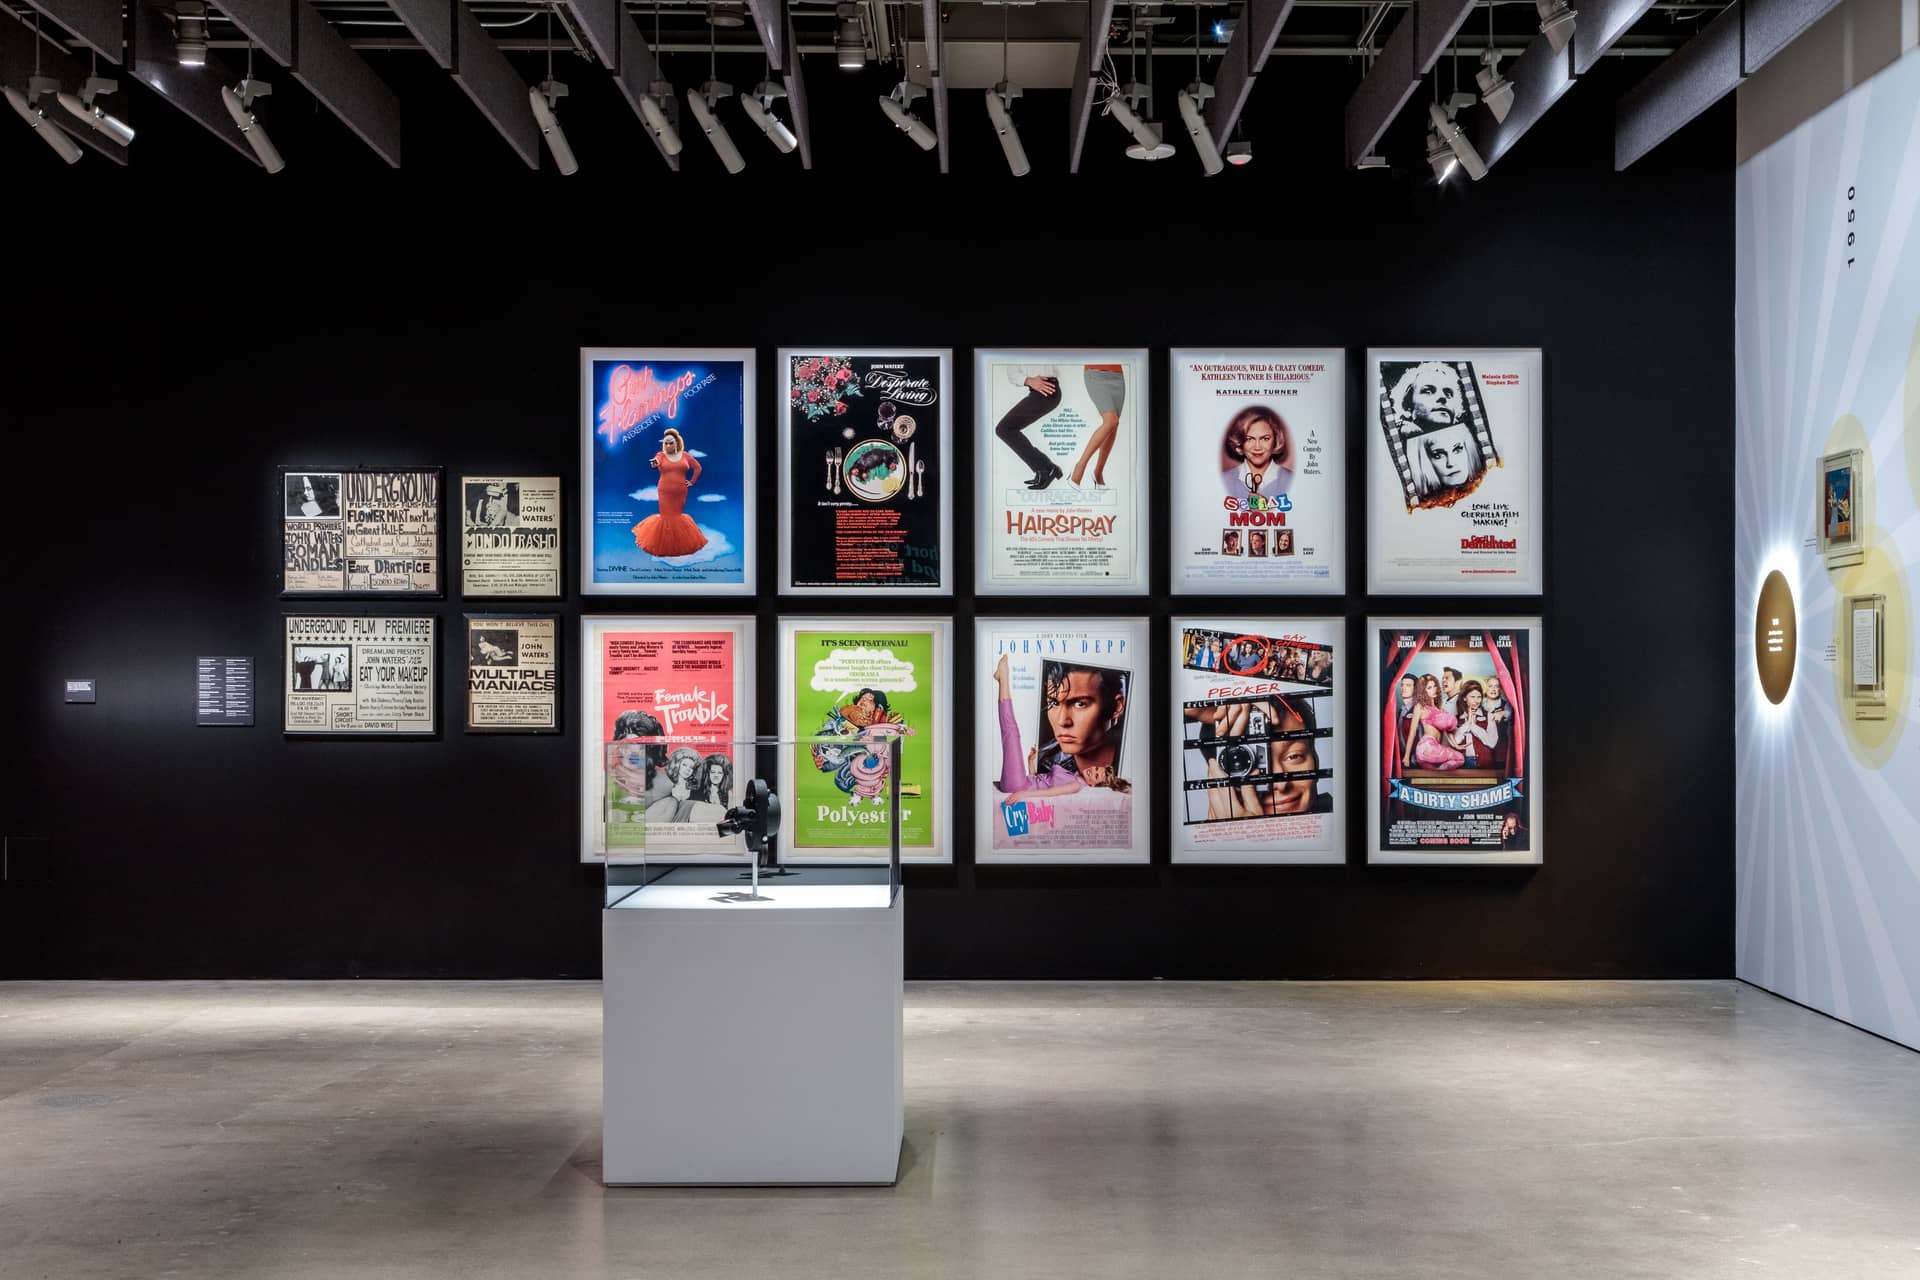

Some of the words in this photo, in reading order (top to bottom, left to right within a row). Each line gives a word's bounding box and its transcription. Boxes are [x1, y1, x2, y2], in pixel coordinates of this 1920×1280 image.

[1848, 186, 1856, 269] 1950
[1204, 364, 1248, 372] OUTRAGEOUS,
[1250, 364, 1266, 372] WILD
[1275, 364, 1296, 372] CRAZY
[865, 370, 930, 393] Desperate
[880, 387, 937, 406] Living
[598, 371, 696, 443] Flamingos
[347, 472, 437, 502] UNDERGROUND
[348, 510, 385, 522] FLOWER
[386, 508, 410, 522] MART
[1230, 512, 1286, 526] MOM
[1473, 519, 1508, 527] MAKING!
[1006, 510, 1117, 537] HAIRSPRAY
[285, 532, 310, 544] JOHN
[1461, 539, 1517, 549] Demented
[286, 544, 340, 560] ROMAN
[289, 620, 347, 634] UNDERGROUND
[353, 620, 376, 634] FILM
[385, 620, 430, 634] PREMIERE
[999, 640, 1068, 654] JOHNNY
[1082, 640, 1126, 654] DEPP
[360, 666, 373, 681] EAT
[376, 666, 395, 682] YOUR
[398, 666, 428, 682] MAKEUP
[469, 670, 556, 680] MULTIPLE
[468, 680, 556, 690] MANIACS
[1207, 682, 1280, 699] PECKER
[654, 685, 710, 704] Female
[654, 691, 729, 733] Trouble
[1400, 789, 1409, 801] A
[1414, 791, 1456, 808] DIRTY
[1461, 786, 1512, 808] SHAME
[817, 805, 912, 826] Polyestr
[1028, 800, 1055, 828] Baby
